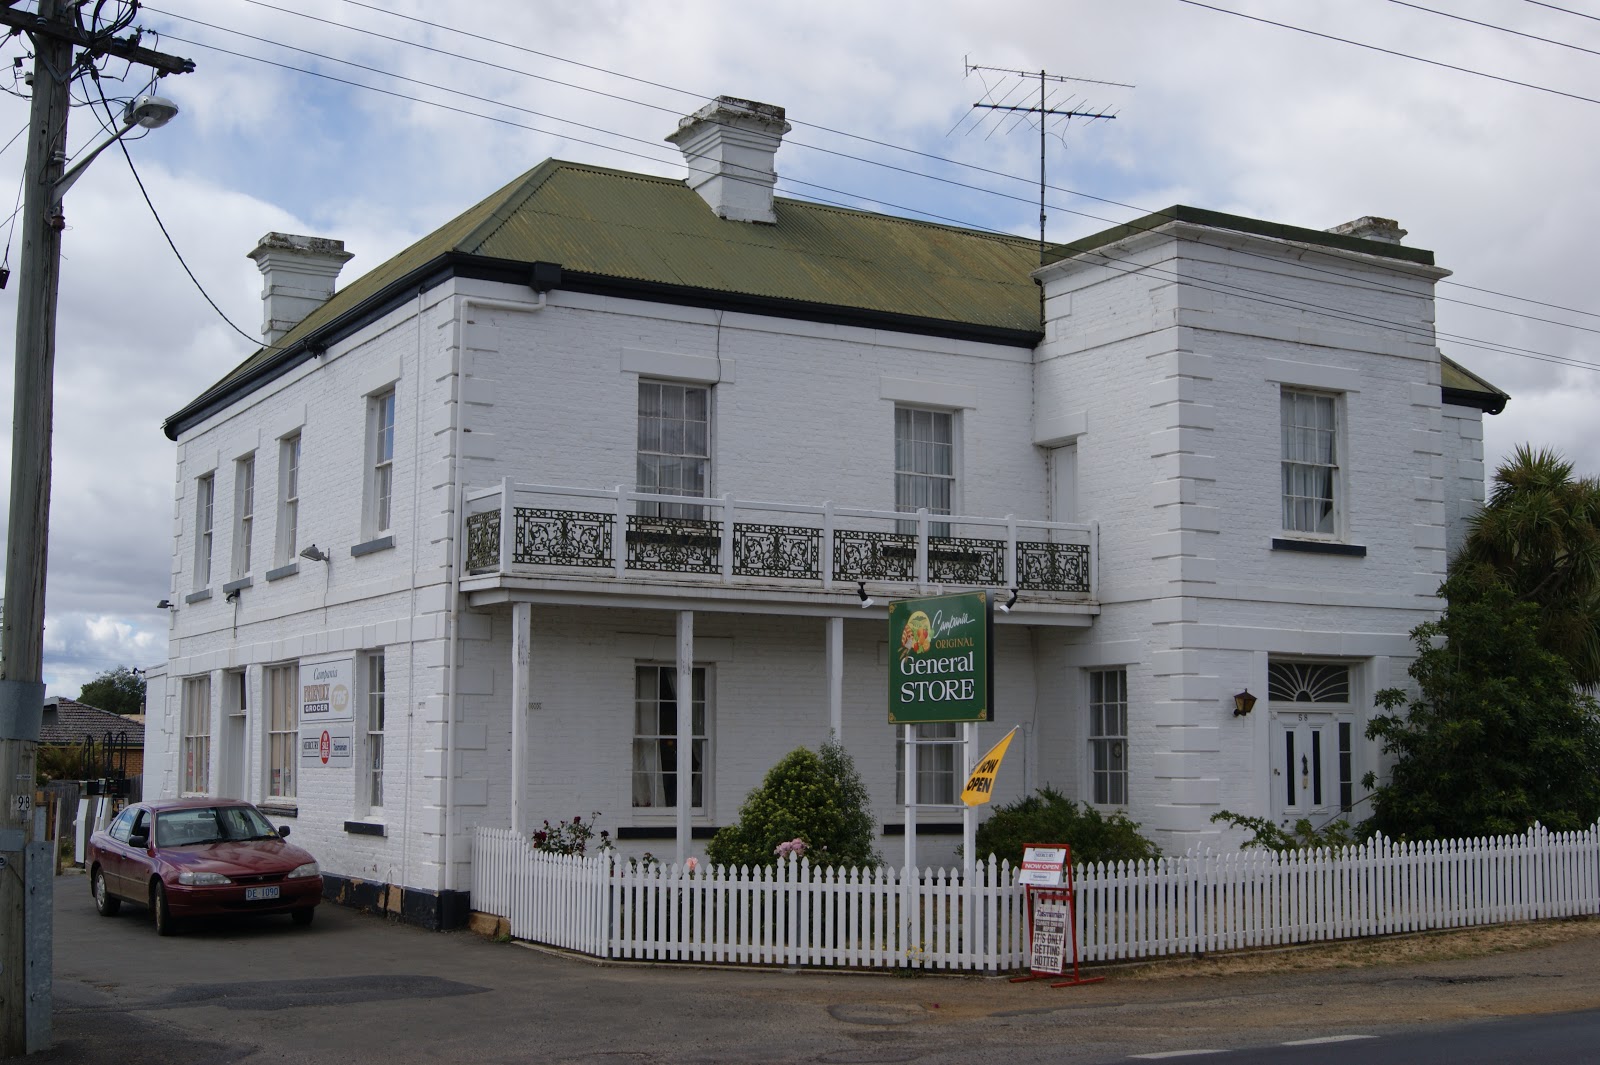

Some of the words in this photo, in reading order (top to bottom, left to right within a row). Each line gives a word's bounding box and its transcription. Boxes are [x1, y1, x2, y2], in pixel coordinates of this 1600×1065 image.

[932, 609, 975, 638] Campania
[935, 637, 975, 650] ORIGINAL
[900, 650, 975, 676] General
[900, 678, 975, 703] STORE
[304, 703, 329, 713] GROCER
[1298, 713, 1308, 722] 58
[976, 759, 999, 774] NOW
[966, 777, 992, 793] OPEN
[18, 796, 30, 809] 98
[247, 889, 257, 898] DE
[262, 887, 279, 896] 1090
[1034, 933, 1046, 943] IT'S
[1047, 933, 1063, 945] ONLY
[1034, 944, 1060, 956] GETTING
[1034, 955, 1059, 967] HOTTER
